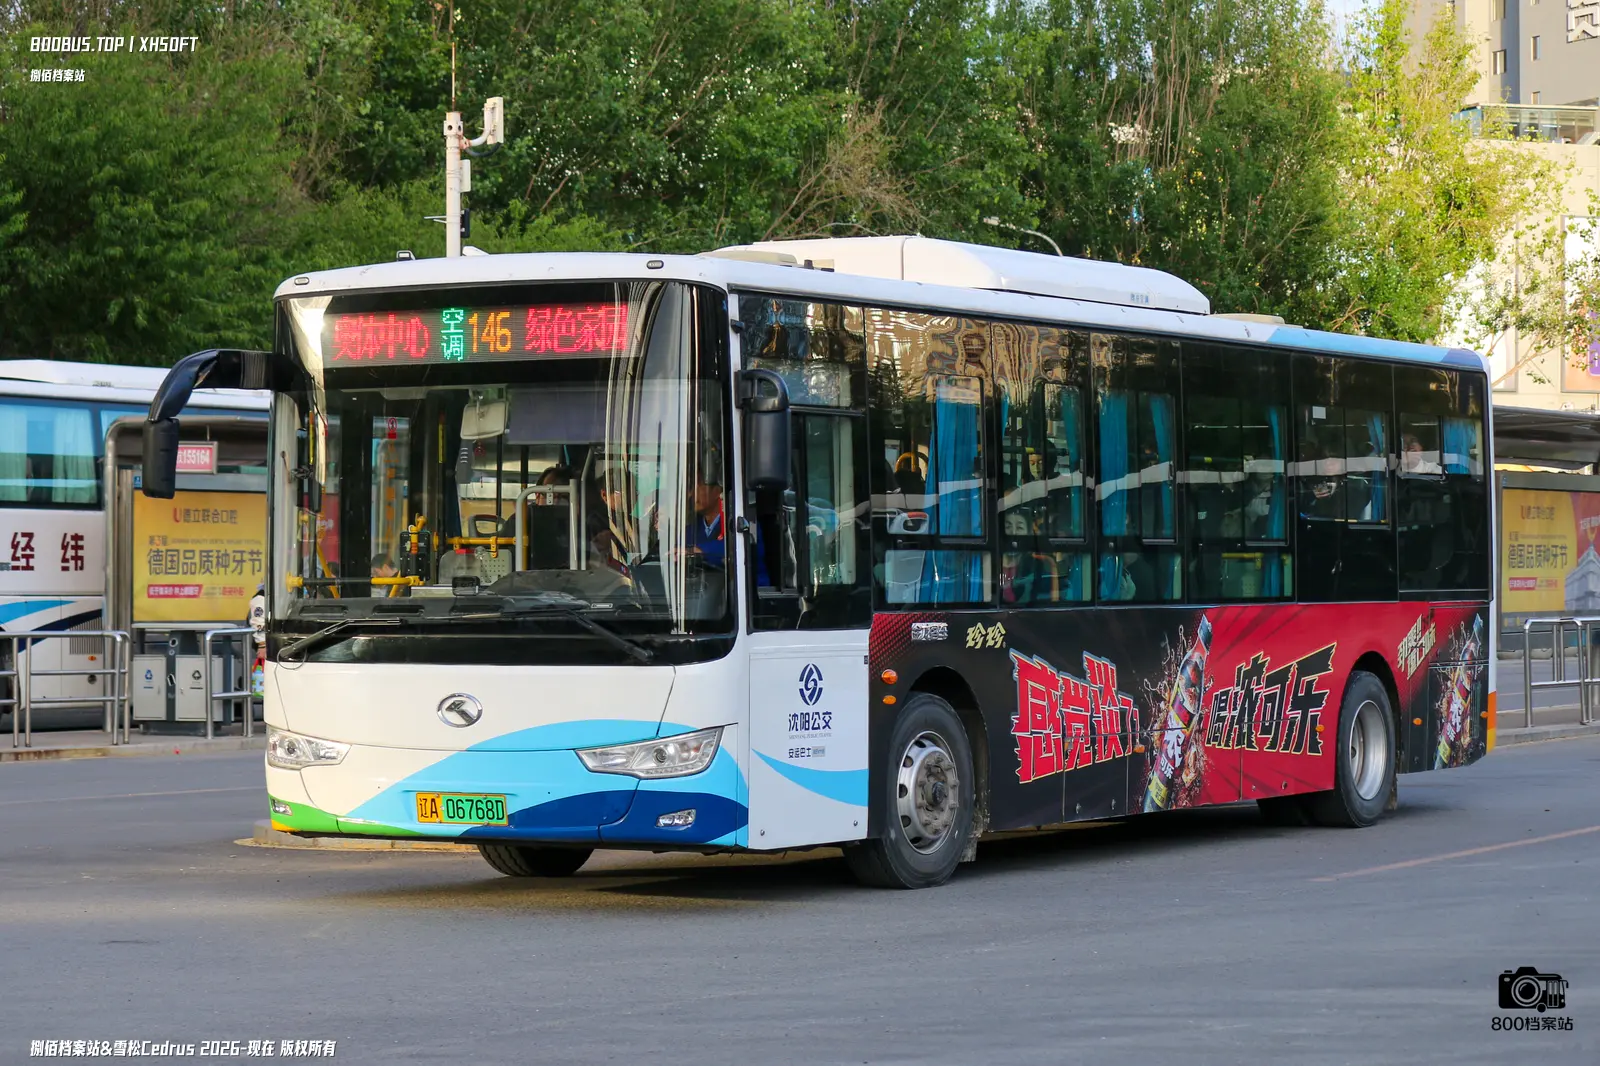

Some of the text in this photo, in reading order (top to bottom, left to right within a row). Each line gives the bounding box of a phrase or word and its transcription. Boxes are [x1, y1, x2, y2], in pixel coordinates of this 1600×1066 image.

[441, 308, 465, 362] 空调
[468, 311, 512, 353] 146
[147, 548, 263, 576] 德国品质种牙节
[1205, 641, 1337, 755] 喝浓可乐
[788, 711, 833, 732] 沈阳公交
[419, 798, 505, 820] 辽A 06768D
